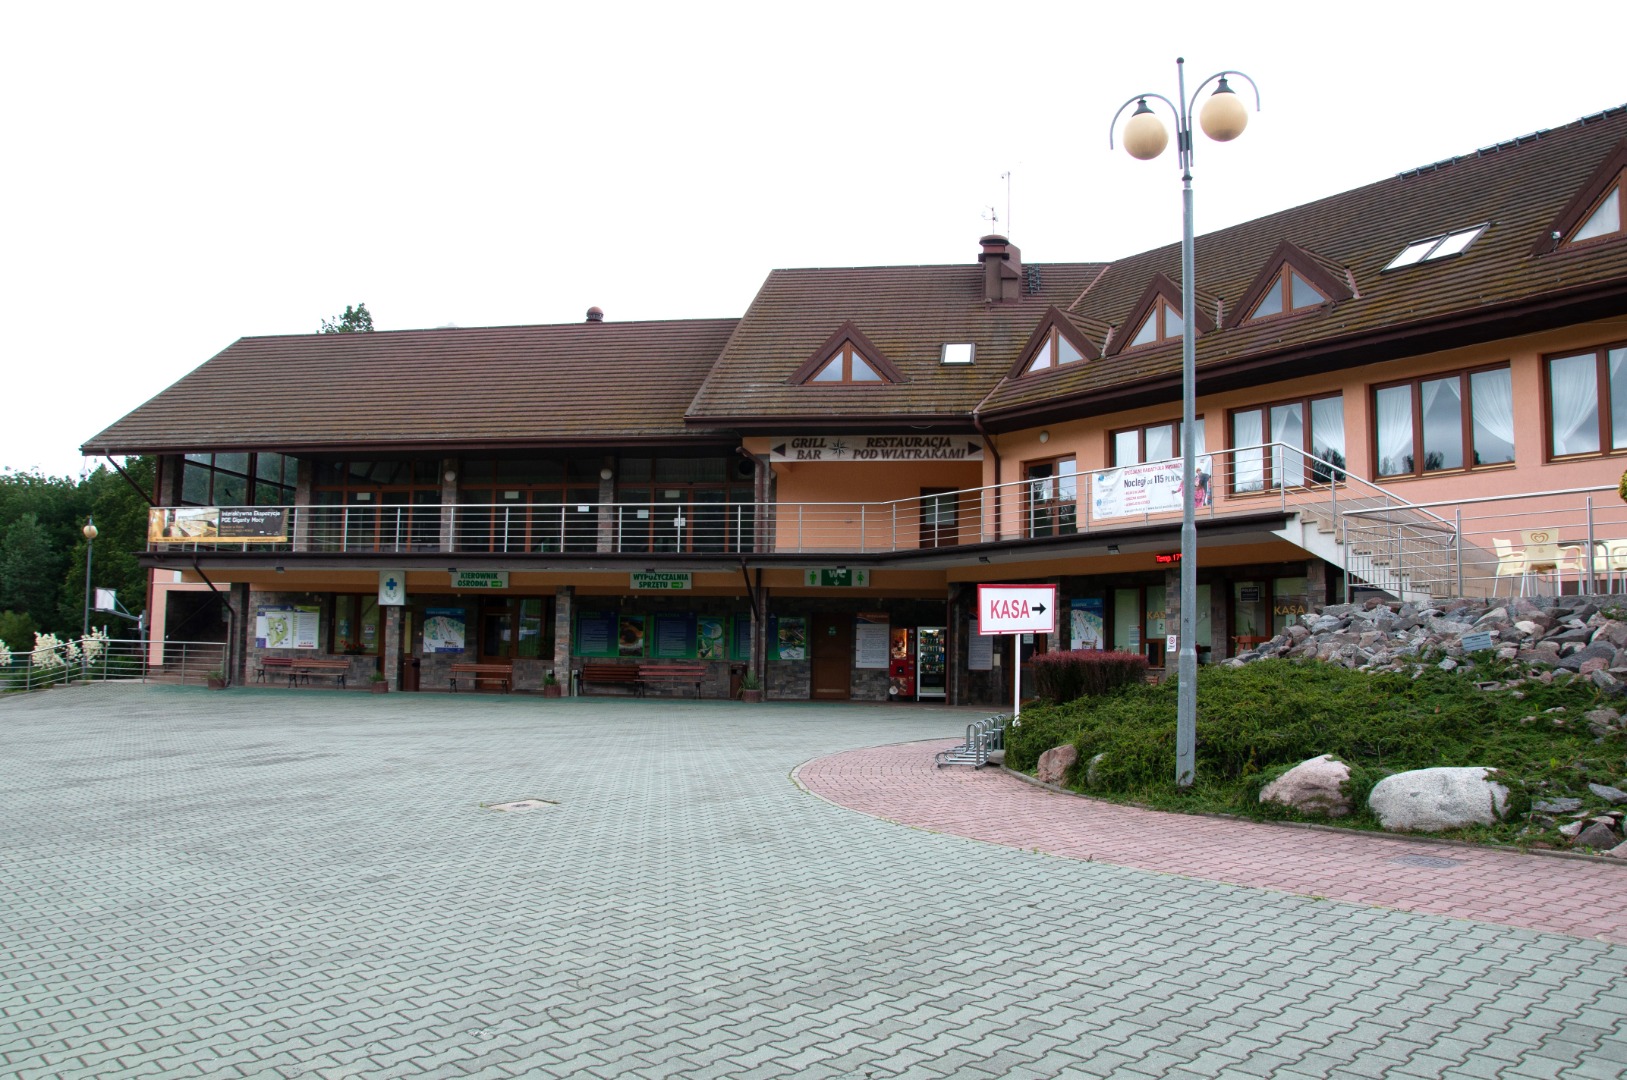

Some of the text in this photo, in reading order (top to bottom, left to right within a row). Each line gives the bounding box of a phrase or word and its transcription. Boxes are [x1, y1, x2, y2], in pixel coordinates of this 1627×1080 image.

[791, 437, 827, 449] GRILL
[865, 436, 952, 449] RESTAURACJA
[796, 449, 822, 460] BAR
[852, 447, 966, 460] POD WIATRAKAMI
[1124, 476, 1146, 488] Noclegi
[1154, 474, 1164, 484] 115
[633, 573, 689, 581] WYPOŻYCZALNIA
[828, 570, 846, 578] WC
[457, 579, 488, 587] OŚRODKA
[638, 581, 668, 589] SPRZĘTU
[990, 599, 1030, 619] KASA
[1273, 604, 1305, 615] KASA
[1147, 610, 1166, 620] KAS
